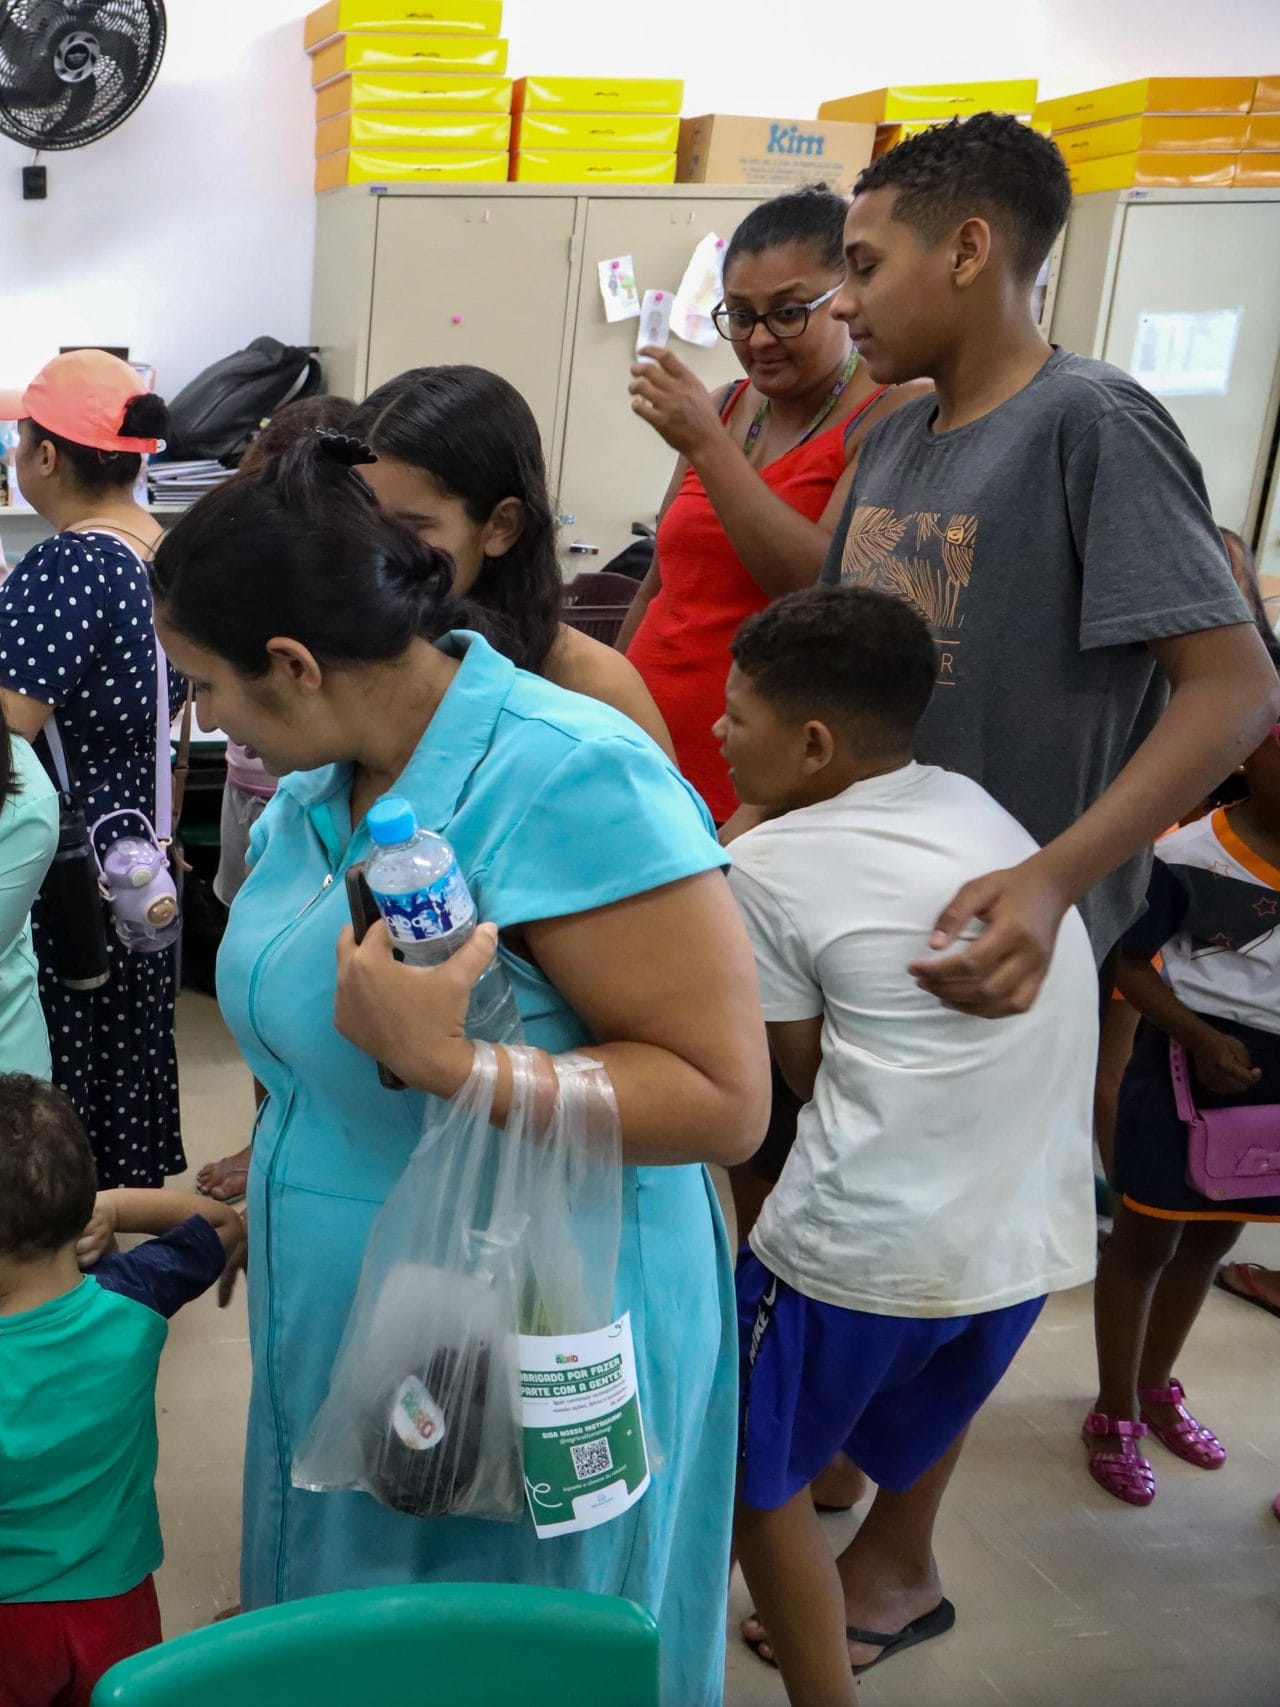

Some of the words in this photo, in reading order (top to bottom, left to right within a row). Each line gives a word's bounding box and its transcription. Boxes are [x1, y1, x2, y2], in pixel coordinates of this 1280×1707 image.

[767, 123, 825, 155] Kim
[567, 1368, 588, 1380] POR
[591, 1356, 621, 1375] FAZER
[520, 1385, 551, 1397] PARTE
[553, 1385, 577, 1396] COM
[579, 1382, 587, 1392] A
